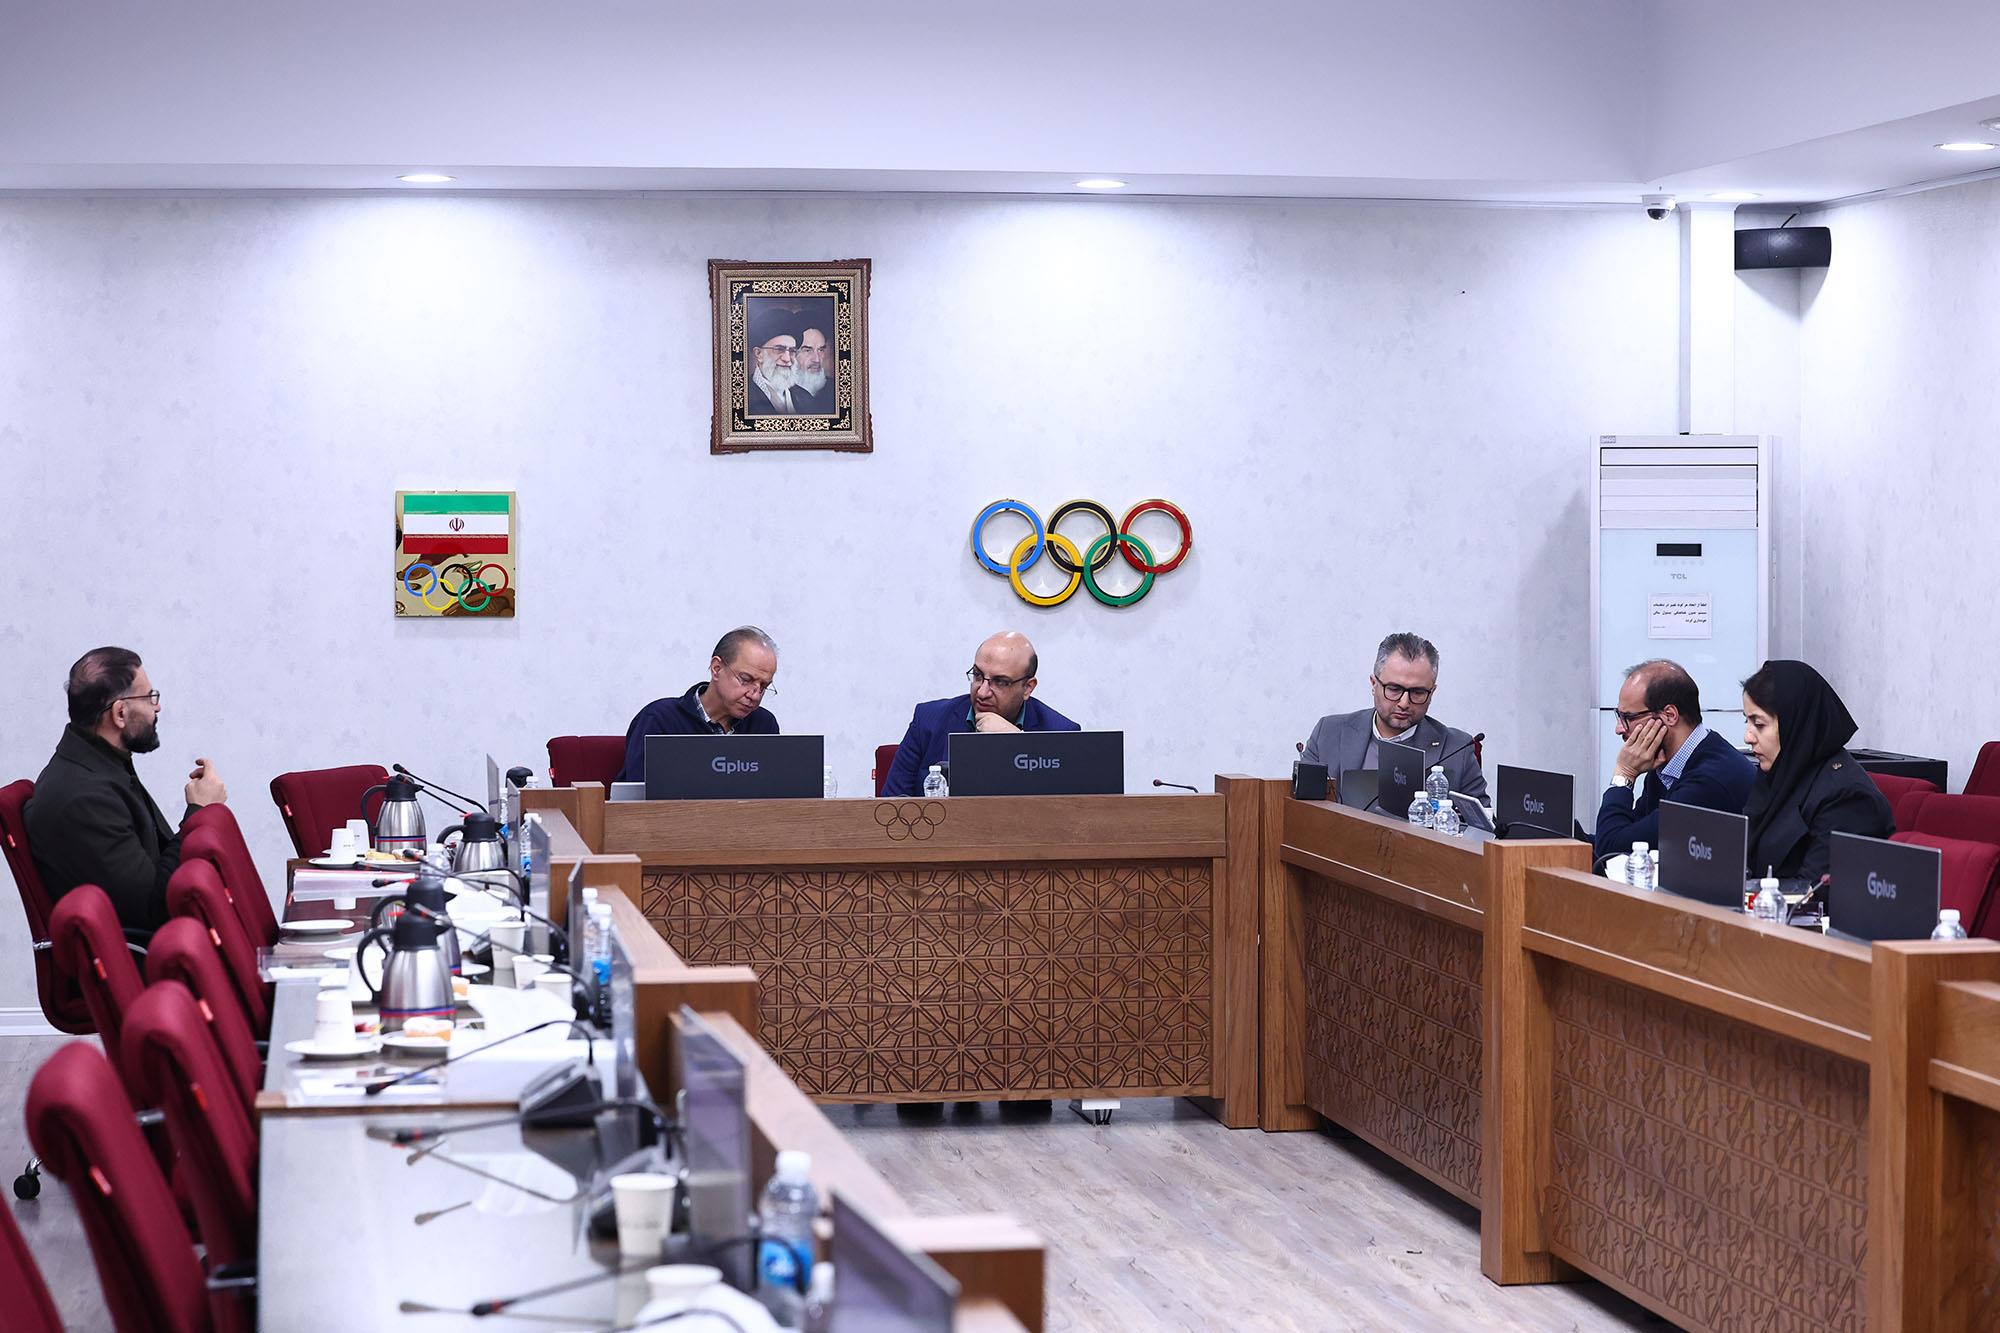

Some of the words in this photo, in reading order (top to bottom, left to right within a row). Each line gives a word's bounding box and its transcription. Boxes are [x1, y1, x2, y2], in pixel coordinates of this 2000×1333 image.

[711, 756, 760, 775] Gplus
[1013, 753, 1061, 772] Gplus
[1393, 766, 1407, 785] Gplus
[1523, 793, 1545, 815] Gplus
[1687, 835, 1713, 861] Gplus
[1866, 871, 1897, 900] Gplus
